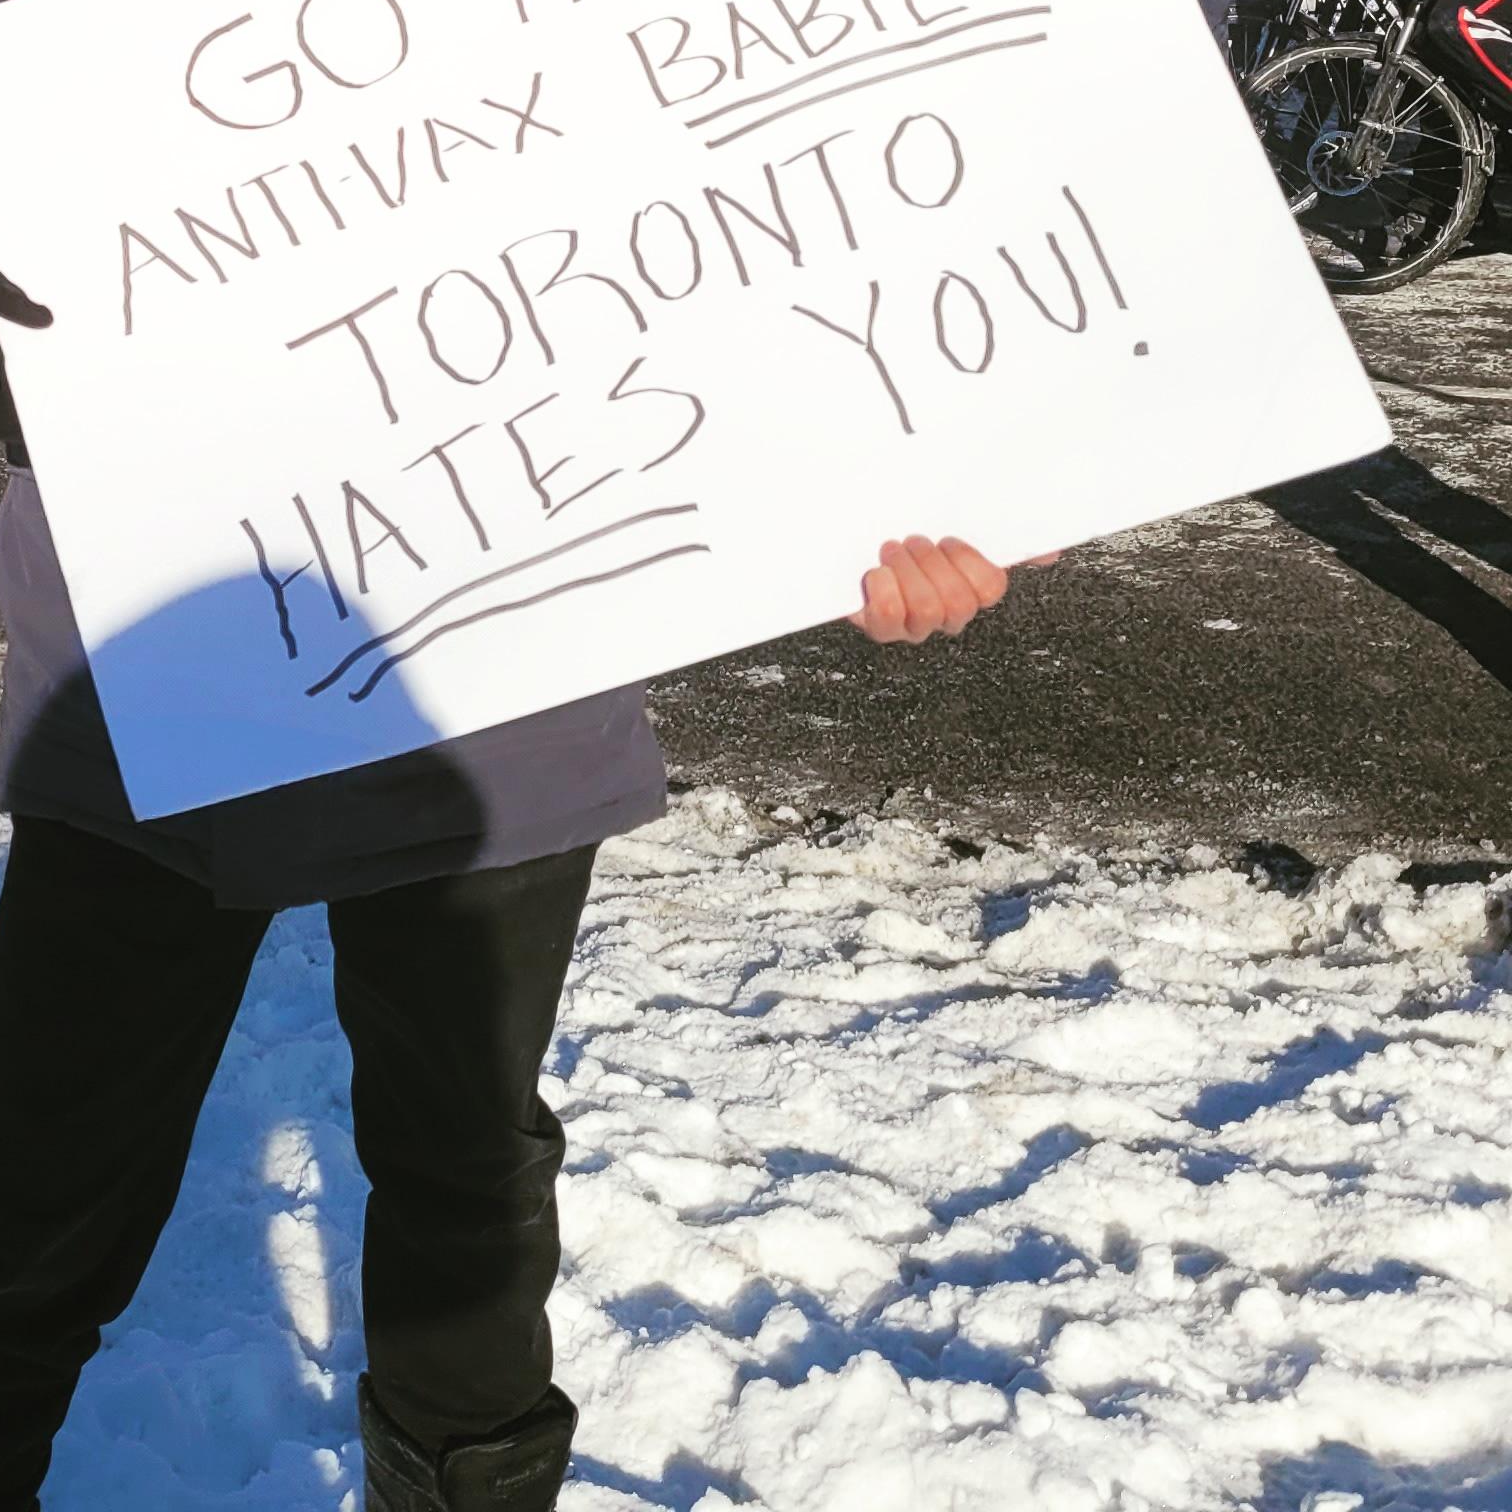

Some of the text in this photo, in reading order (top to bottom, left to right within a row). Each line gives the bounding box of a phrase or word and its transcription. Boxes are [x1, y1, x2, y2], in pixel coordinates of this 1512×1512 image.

[239, 184, 1150, 661] HATES YOU!
[284, 112, 965, 425] TORONTO
